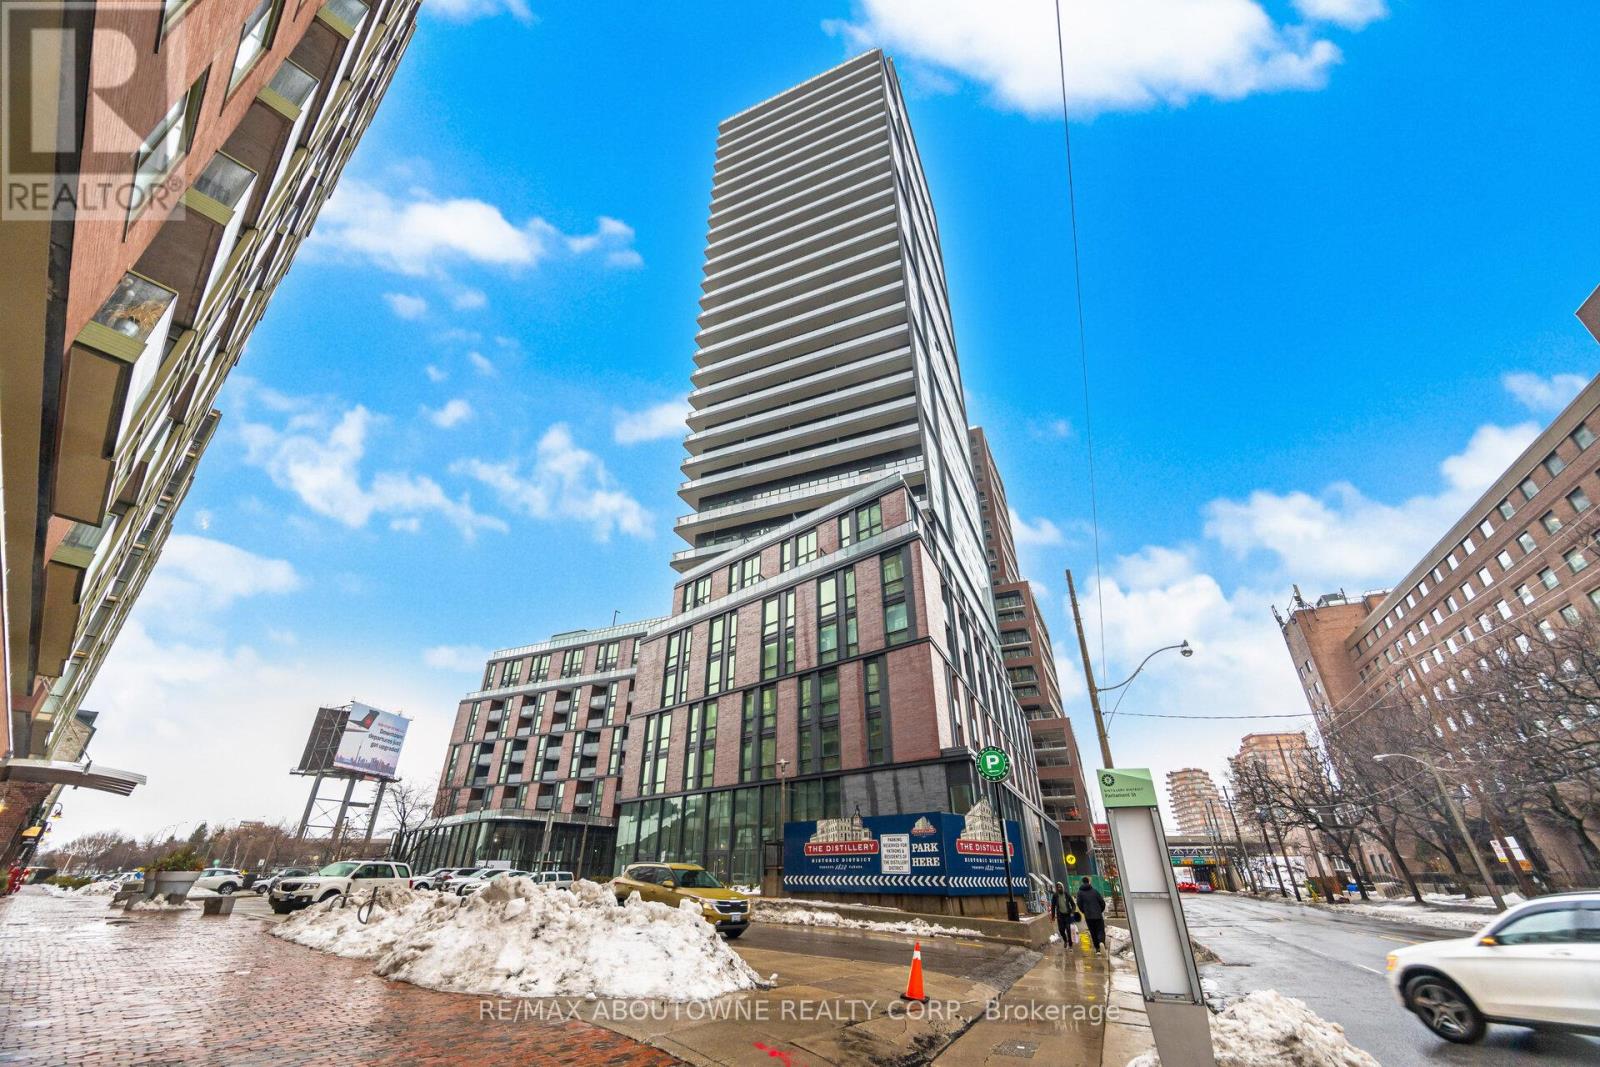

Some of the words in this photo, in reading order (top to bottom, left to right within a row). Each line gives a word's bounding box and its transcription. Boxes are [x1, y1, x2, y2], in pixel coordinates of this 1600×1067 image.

[985, 754, 1000, 770] P
[807, 845, 823, 853] THE
[825, 843, 875, 852] DISTILLERY
[911, 842, 939, 853] PARK
[960, 842, 974, 851] THE
[975, 843, 1011, 853] DISTILLE
[911, 857, 941, 867] HERE
